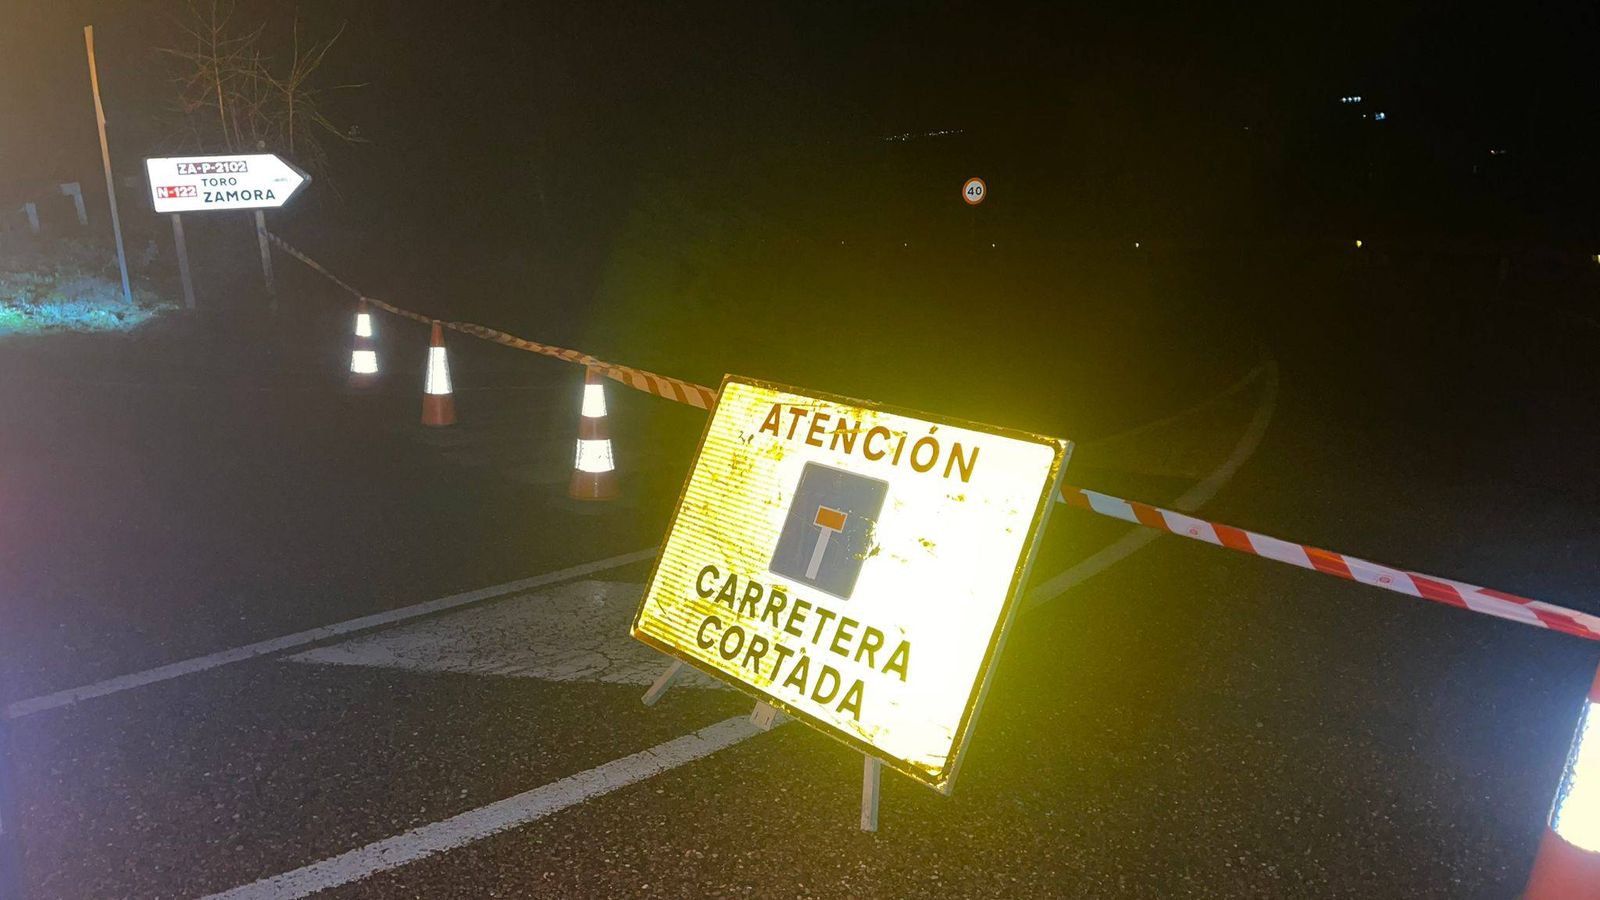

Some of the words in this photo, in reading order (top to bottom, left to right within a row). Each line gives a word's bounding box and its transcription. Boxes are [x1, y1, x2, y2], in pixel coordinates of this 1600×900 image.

[177, 161, 248, 174] ZA-P-2102
[201, 177, 237, 187] TORO
[157, 186, 197, 198] N-122
[203, 189, 276, 202] ZAMORA
[967, 186, 982, 196] 40
[759, 403, 980, 483] ATENCIÓN
[696, 565, 911, 682] CARRETERA
[697, 616, 865, 721] CORTADA
